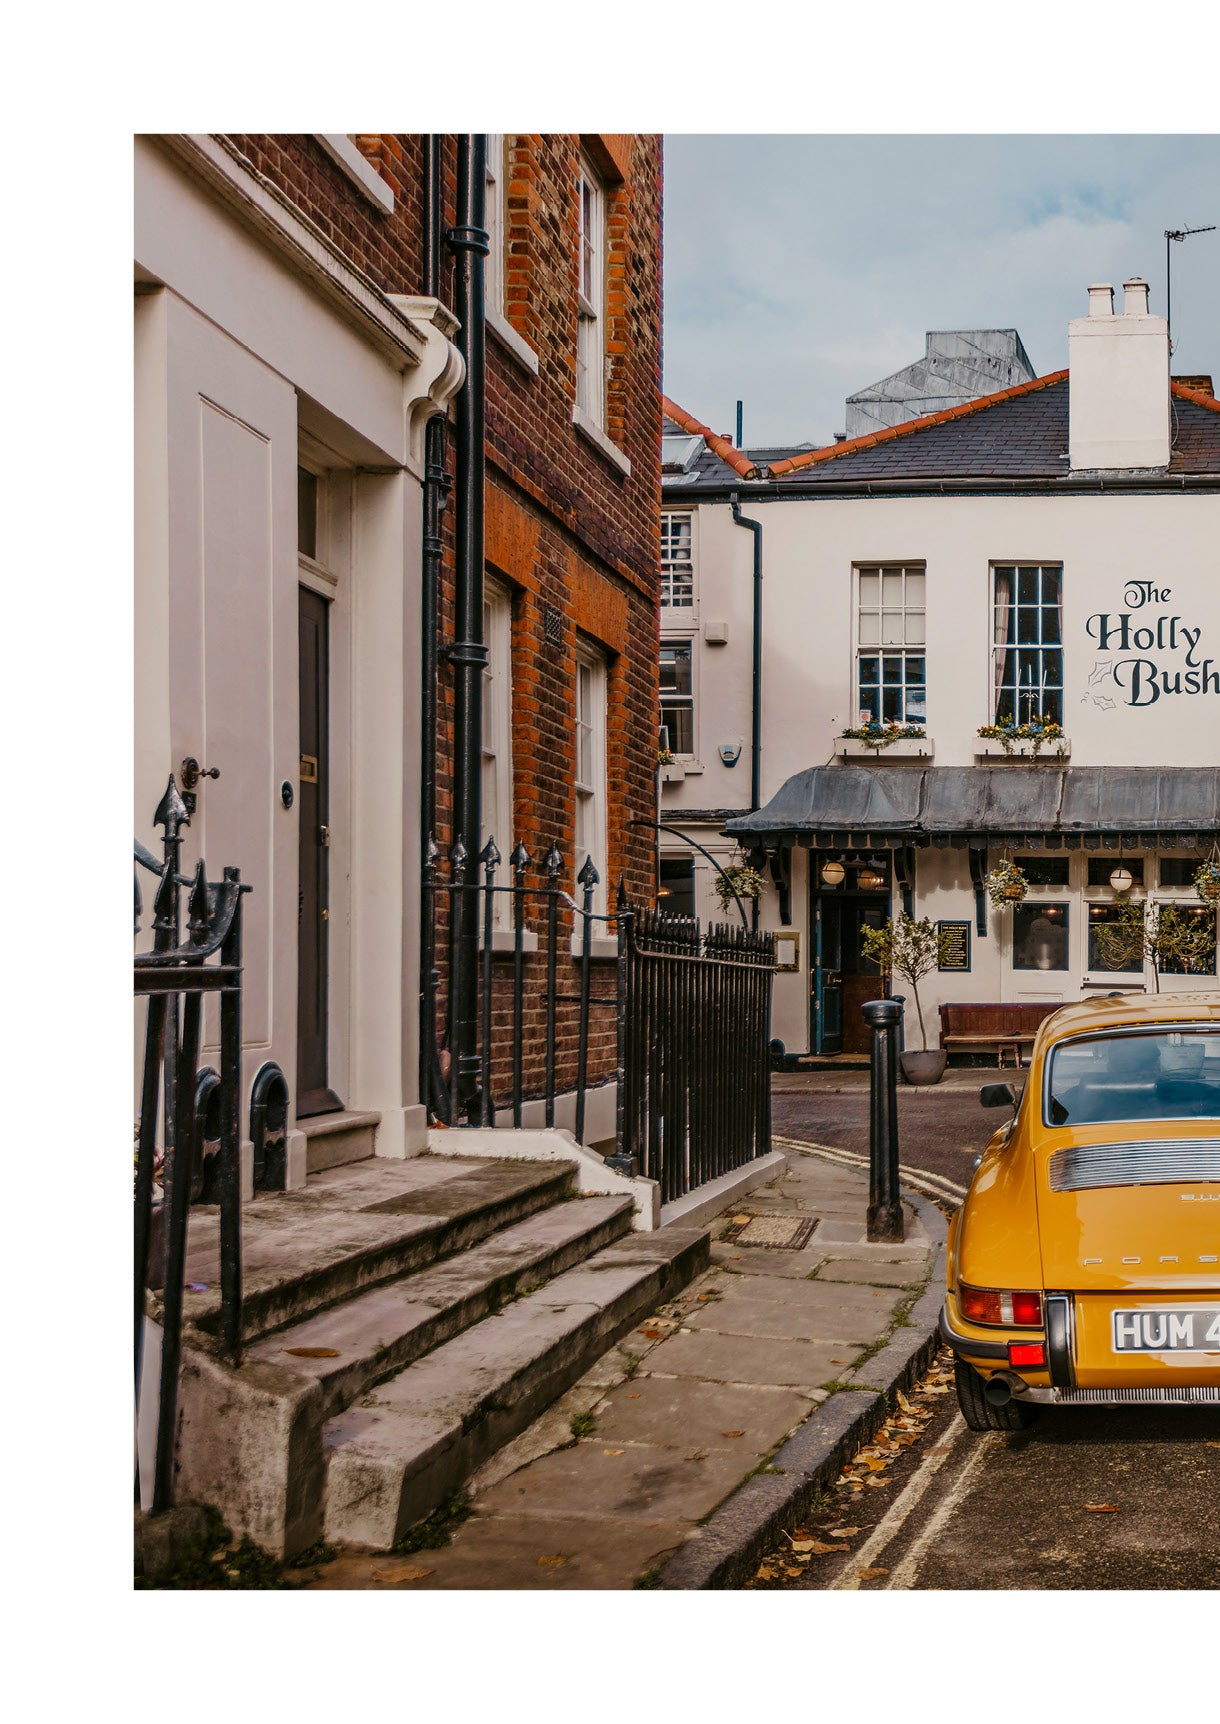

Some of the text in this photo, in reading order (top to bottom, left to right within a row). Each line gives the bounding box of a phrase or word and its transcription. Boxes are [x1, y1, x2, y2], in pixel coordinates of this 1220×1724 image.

[1124, 580, 1172, 609] The
[1086, 613, 1202, 668] Holly
[1116, 1314, 1194, 1348] HUM
